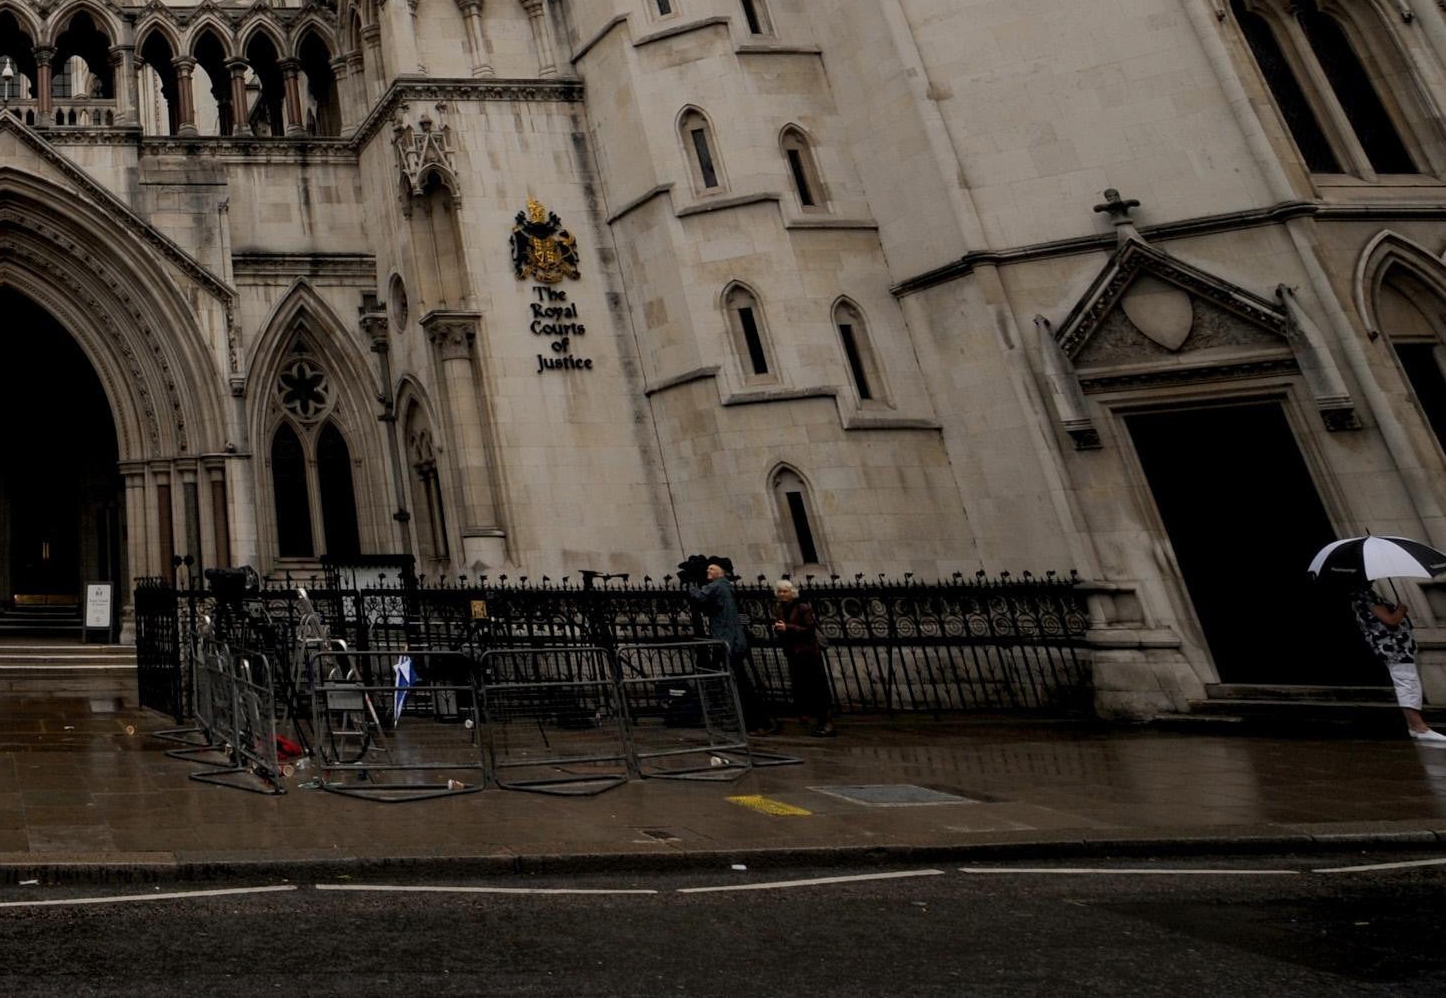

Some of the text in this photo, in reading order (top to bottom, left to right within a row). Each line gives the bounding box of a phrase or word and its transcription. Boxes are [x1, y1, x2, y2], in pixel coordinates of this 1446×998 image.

[532, 286, 567, 302] The
[530, 302, 578, 321] Royal
[530, 320, 586, 336] Courts
[551, 337, 570, 353] of
[537, 354, 594, 374] Justice
